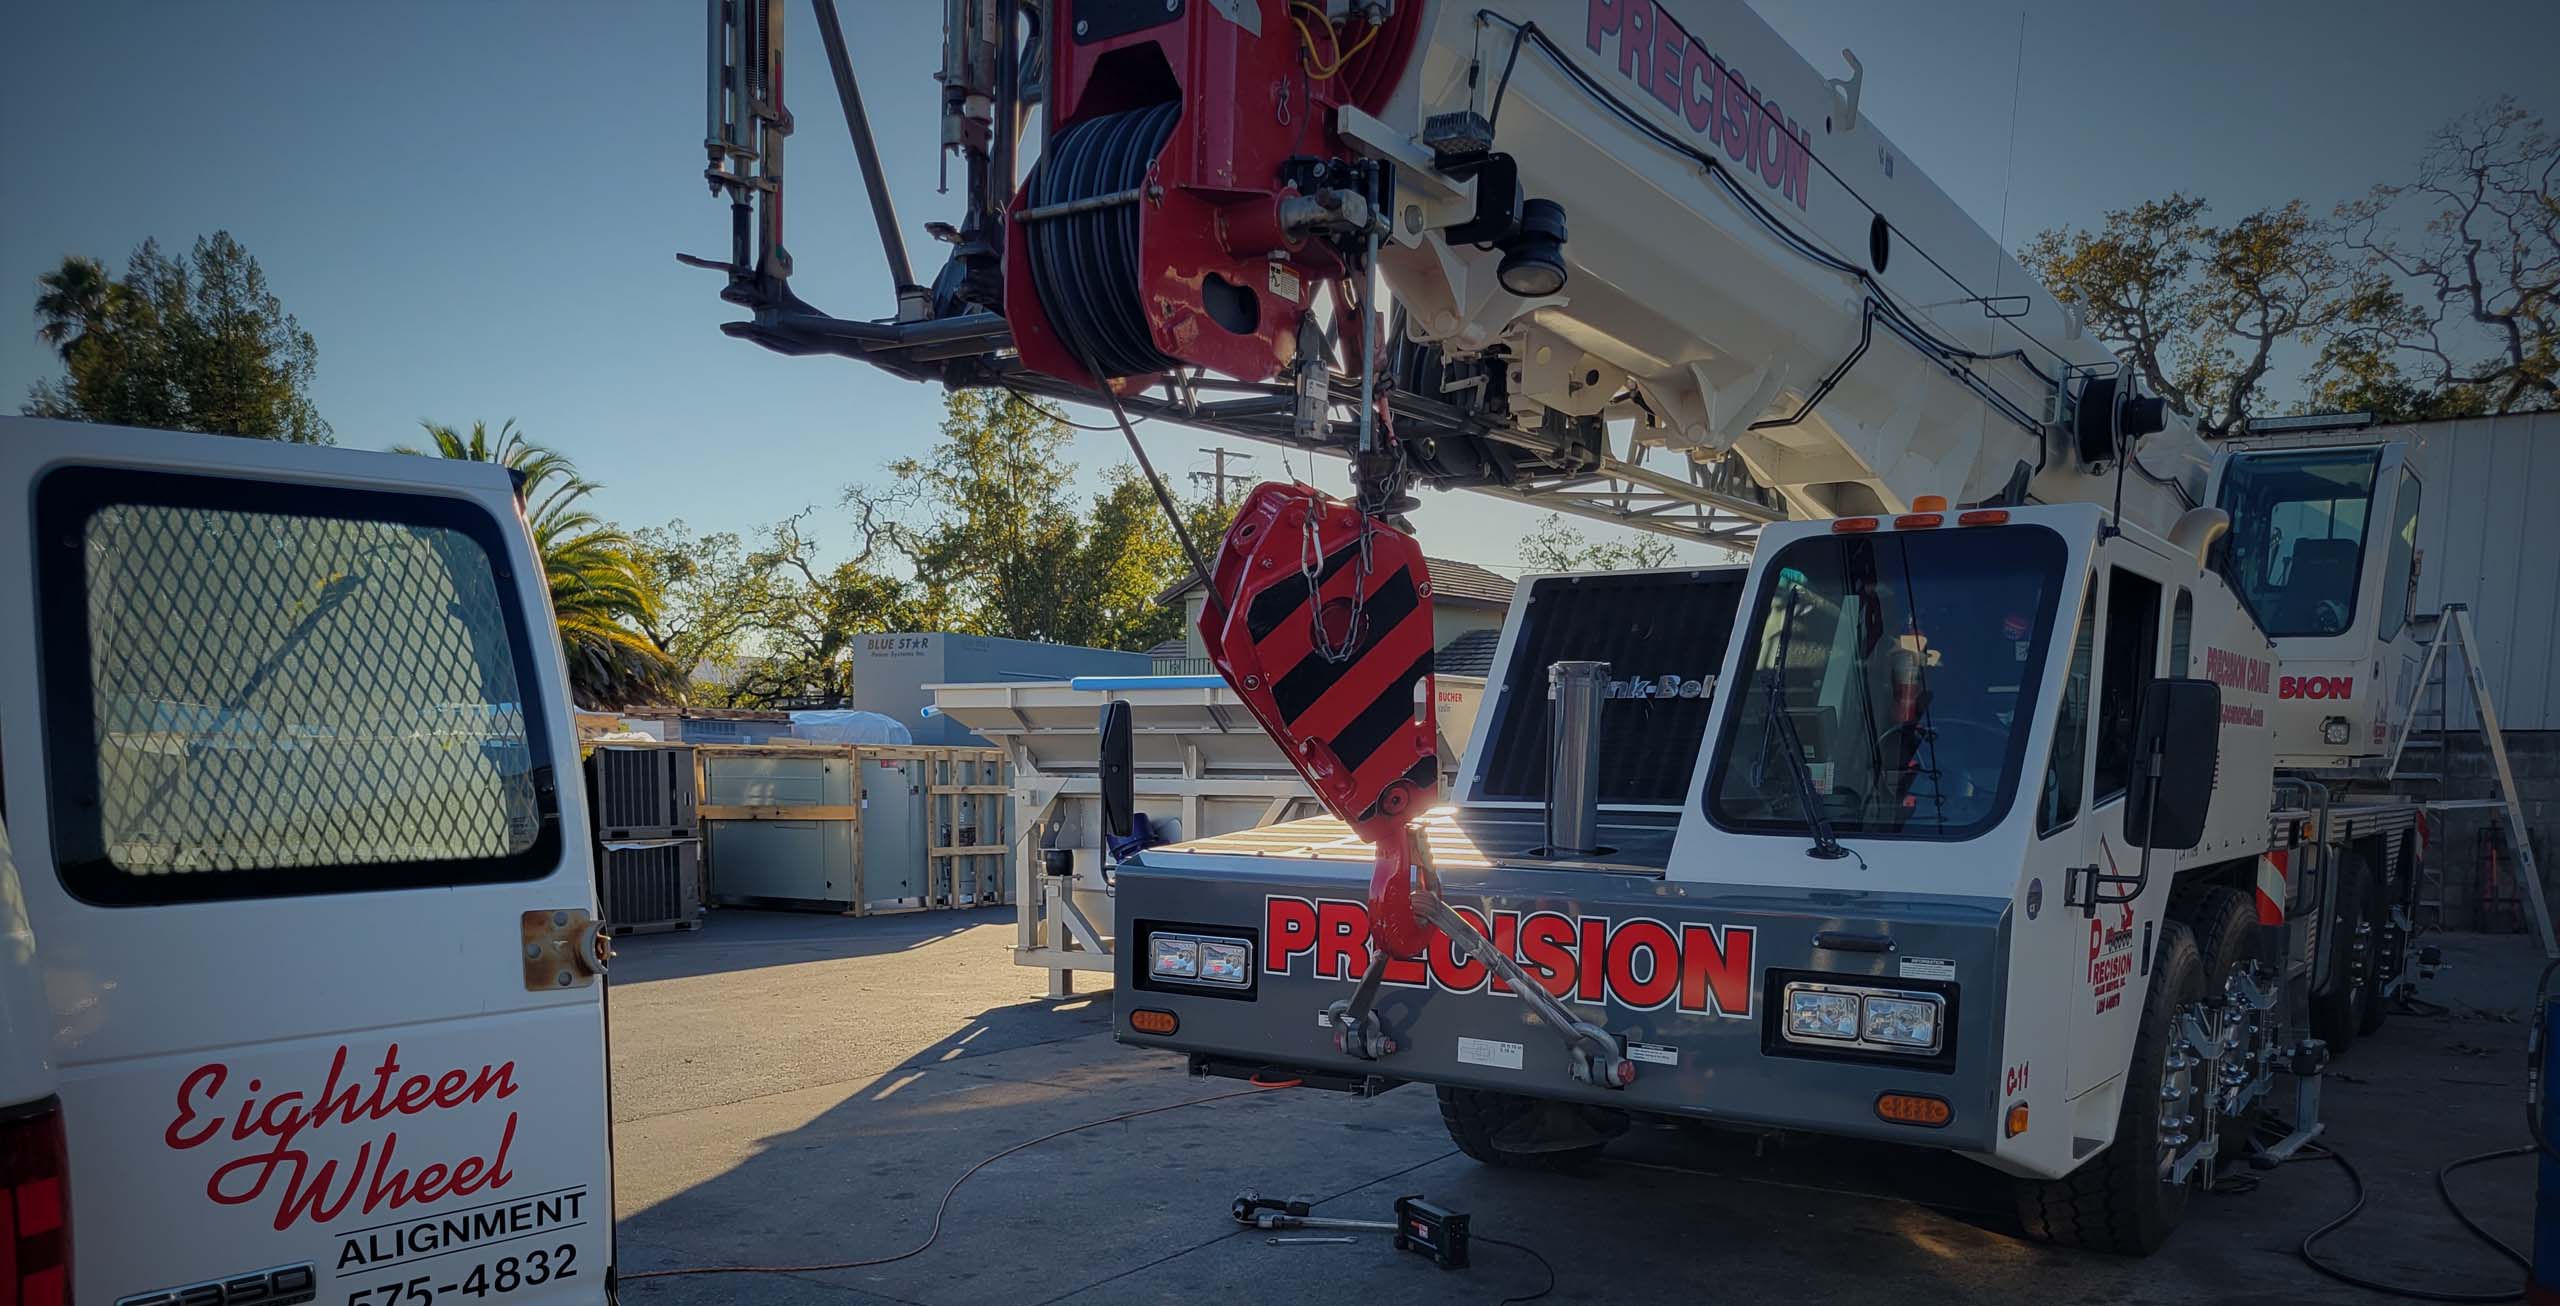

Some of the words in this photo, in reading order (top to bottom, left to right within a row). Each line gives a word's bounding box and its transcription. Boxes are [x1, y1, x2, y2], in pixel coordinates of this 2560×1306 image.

[1586, 0, 1811, 212] PRECISION
[867, 639, 894, 650] BLUE
[1438, 691, 1463, 703] BUCHER
[1604, 675, 1717, 699] nk-Bel
[165, 1043, 519, 1204] Eighteen
[262, 1112, 518, 1231] Wheel
[336, 1191, 588, 1270] ALIGNMENT
